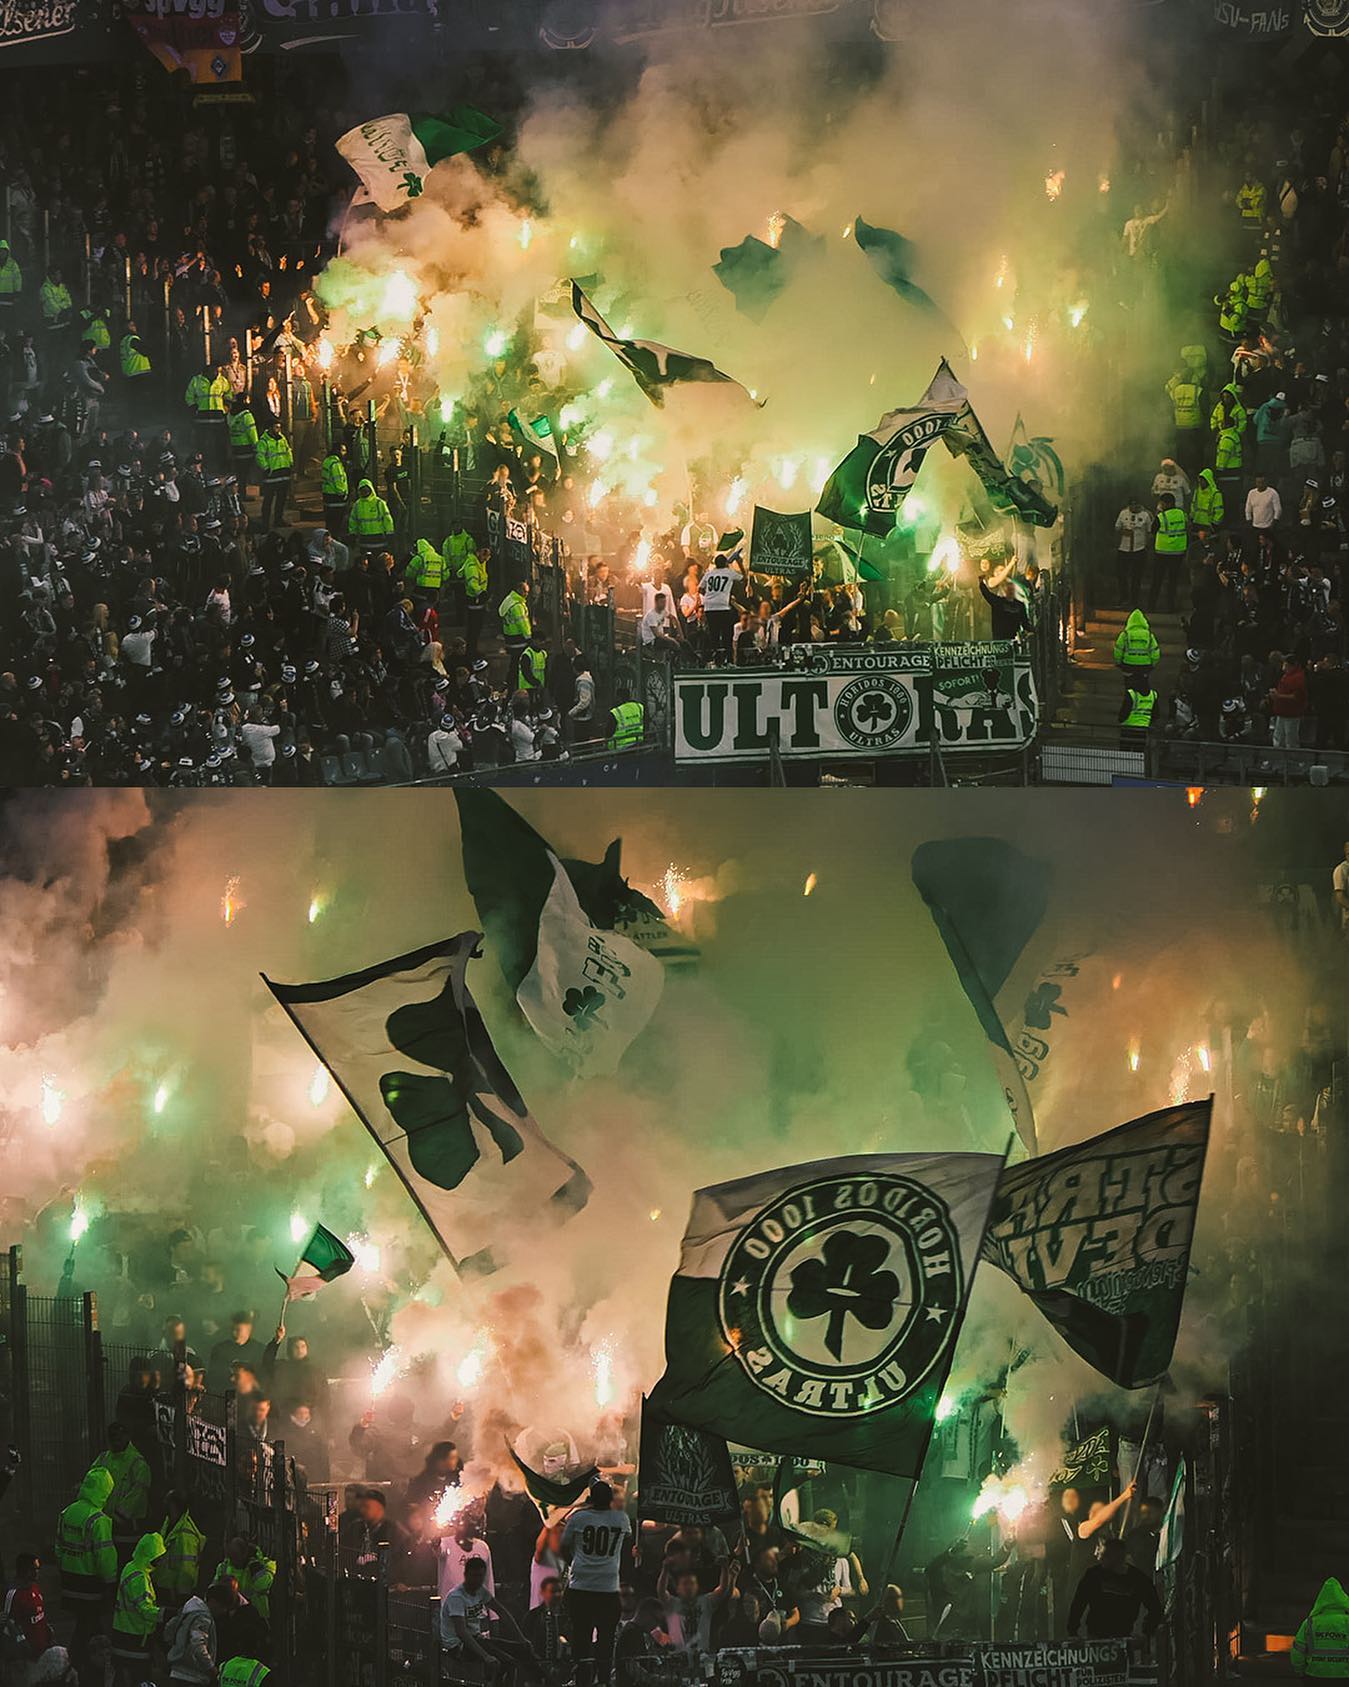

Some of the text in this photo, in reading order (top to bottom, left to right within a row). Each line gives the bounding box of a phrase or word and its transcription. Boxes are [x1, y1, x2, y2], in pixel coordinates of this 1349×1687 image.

[706, 576, 729, 593] 907
[832, 655, 931, 670] ENTOURAGE
[840, 678, 908, 708] HORIDOS 1000
[848, 727, 900, 747] ULTRAS
[582, 1524, 622, 1556] 907
[981, 1647, 1118, 1669] KENNZEICHNUNGS
[793, 1668, 972, 1687] ENTOURAGE
